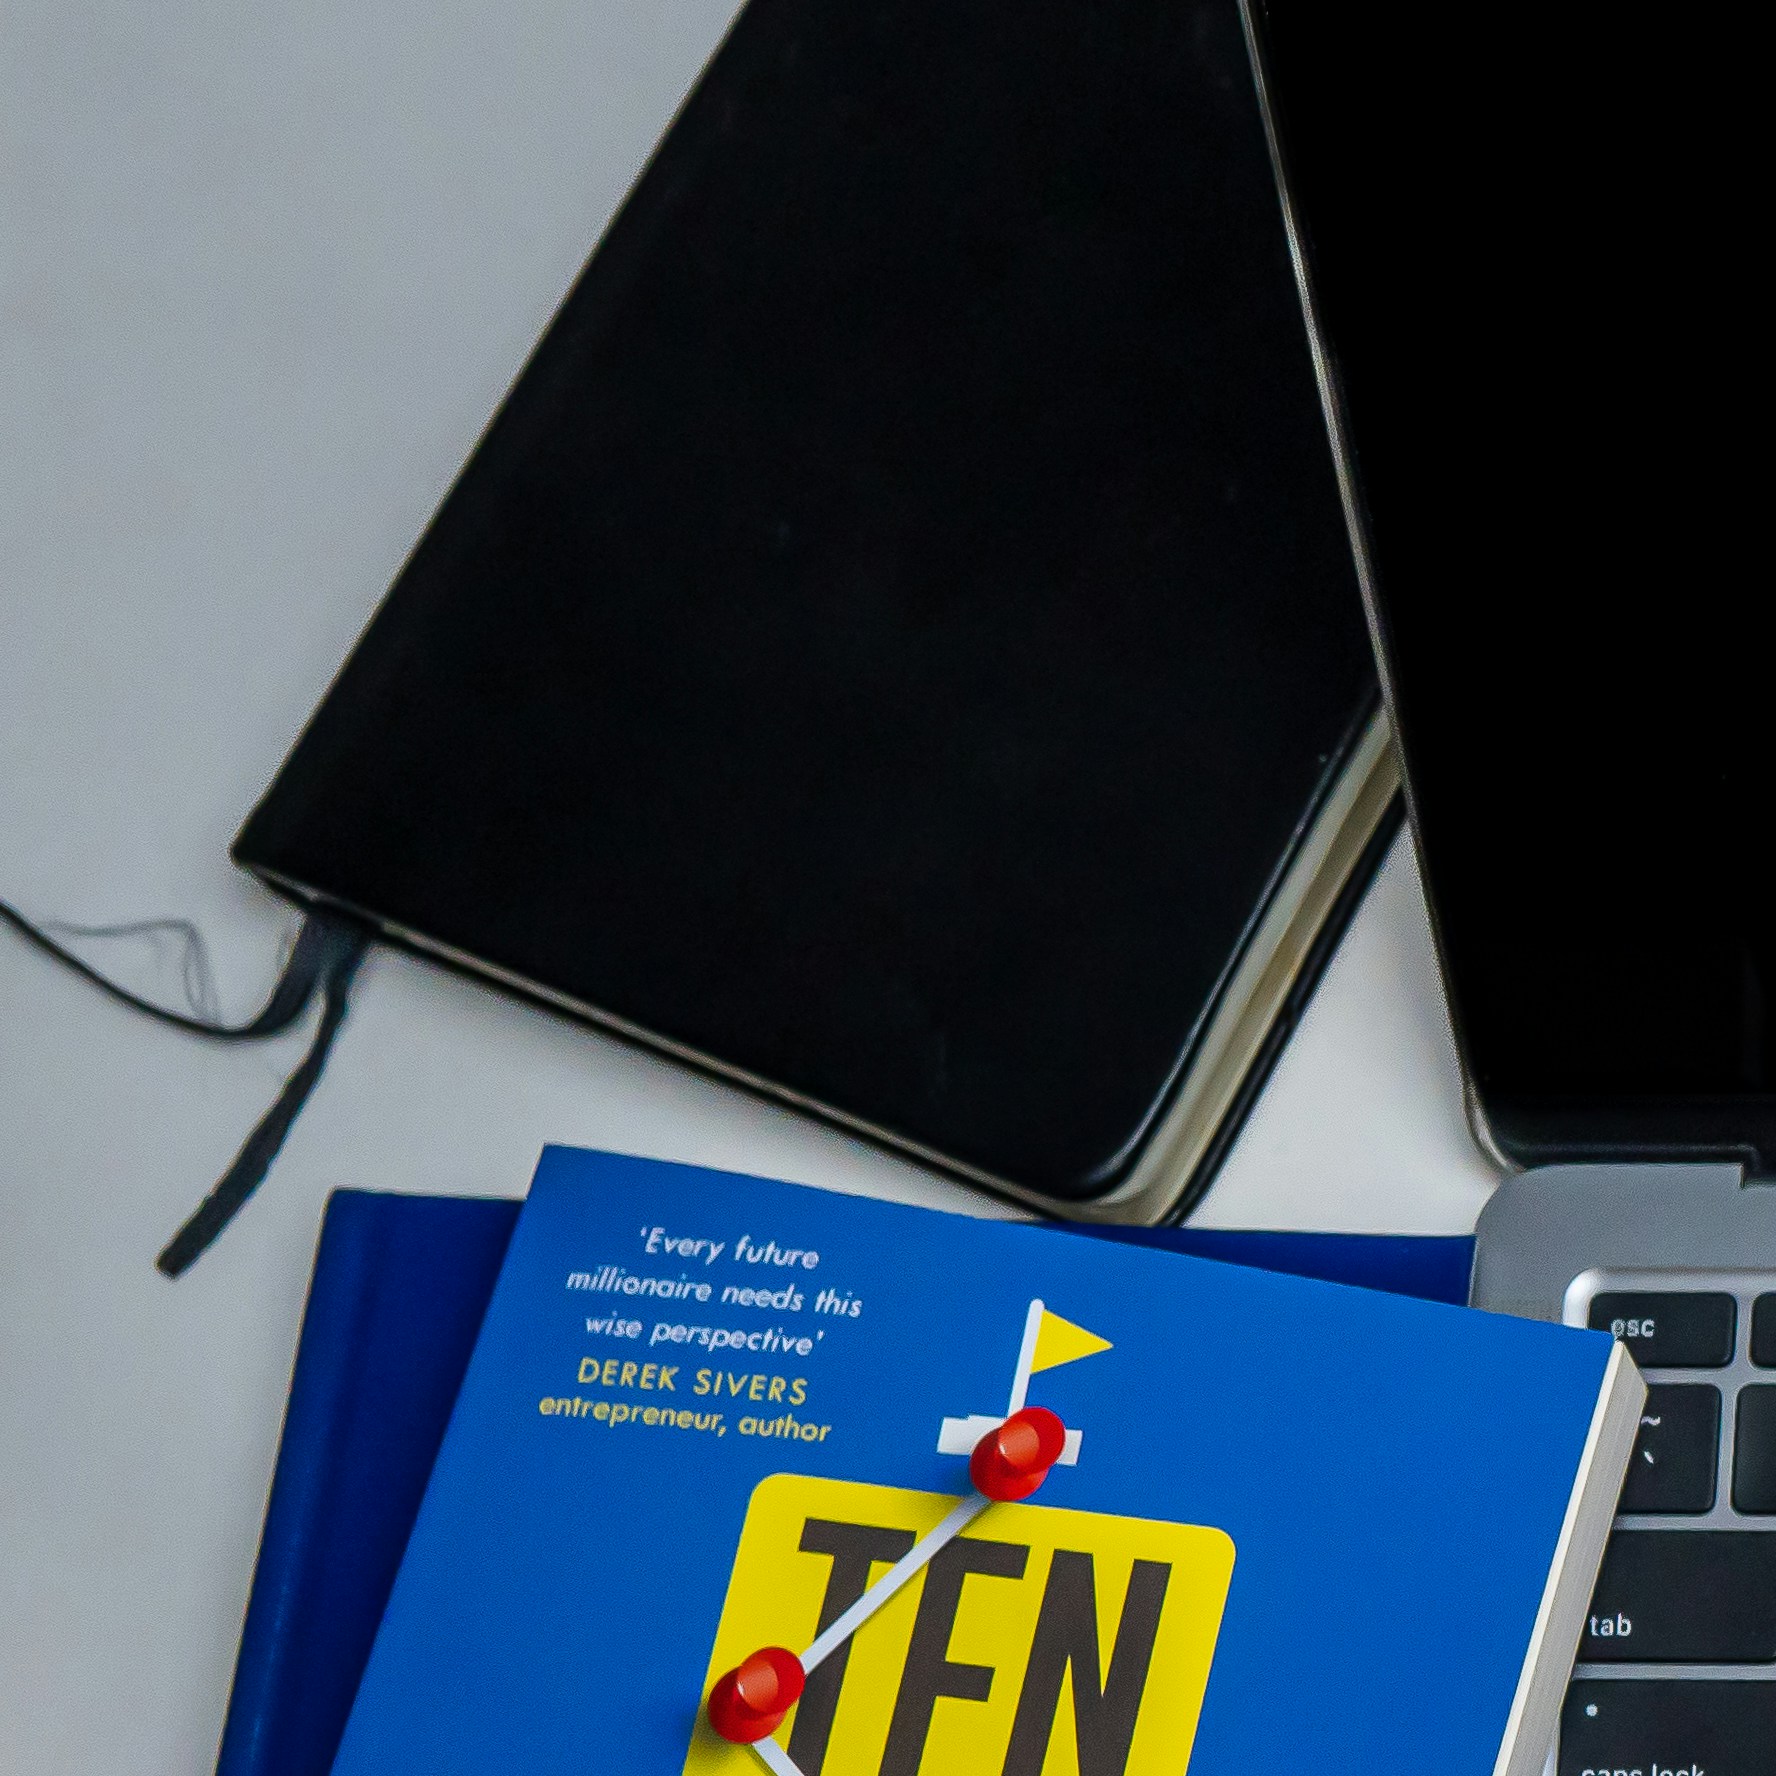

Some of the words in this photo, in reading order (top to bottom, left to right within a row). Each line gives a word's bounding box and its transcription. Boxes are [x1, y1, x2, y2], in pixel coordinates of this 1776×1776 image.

[734, 1234, 820, 1270] future
[566, 1266, 712, 1302] millionaire
[721, 1283, 805, 1312] needs
[814, 1288, 863, 1318] this
[586, 1310, 643, 1339] wise
[1610, 1318, 1656, 1338] esc
[577, 1356, 680, 1391] DEREK
[693, 1368, 808, 1406] SIVERS
[538, 1396, 727, 1438] entrepreneur,
[738, 1413, 832, 1442] author
[1588, 1610, 1632, 1637] tab
